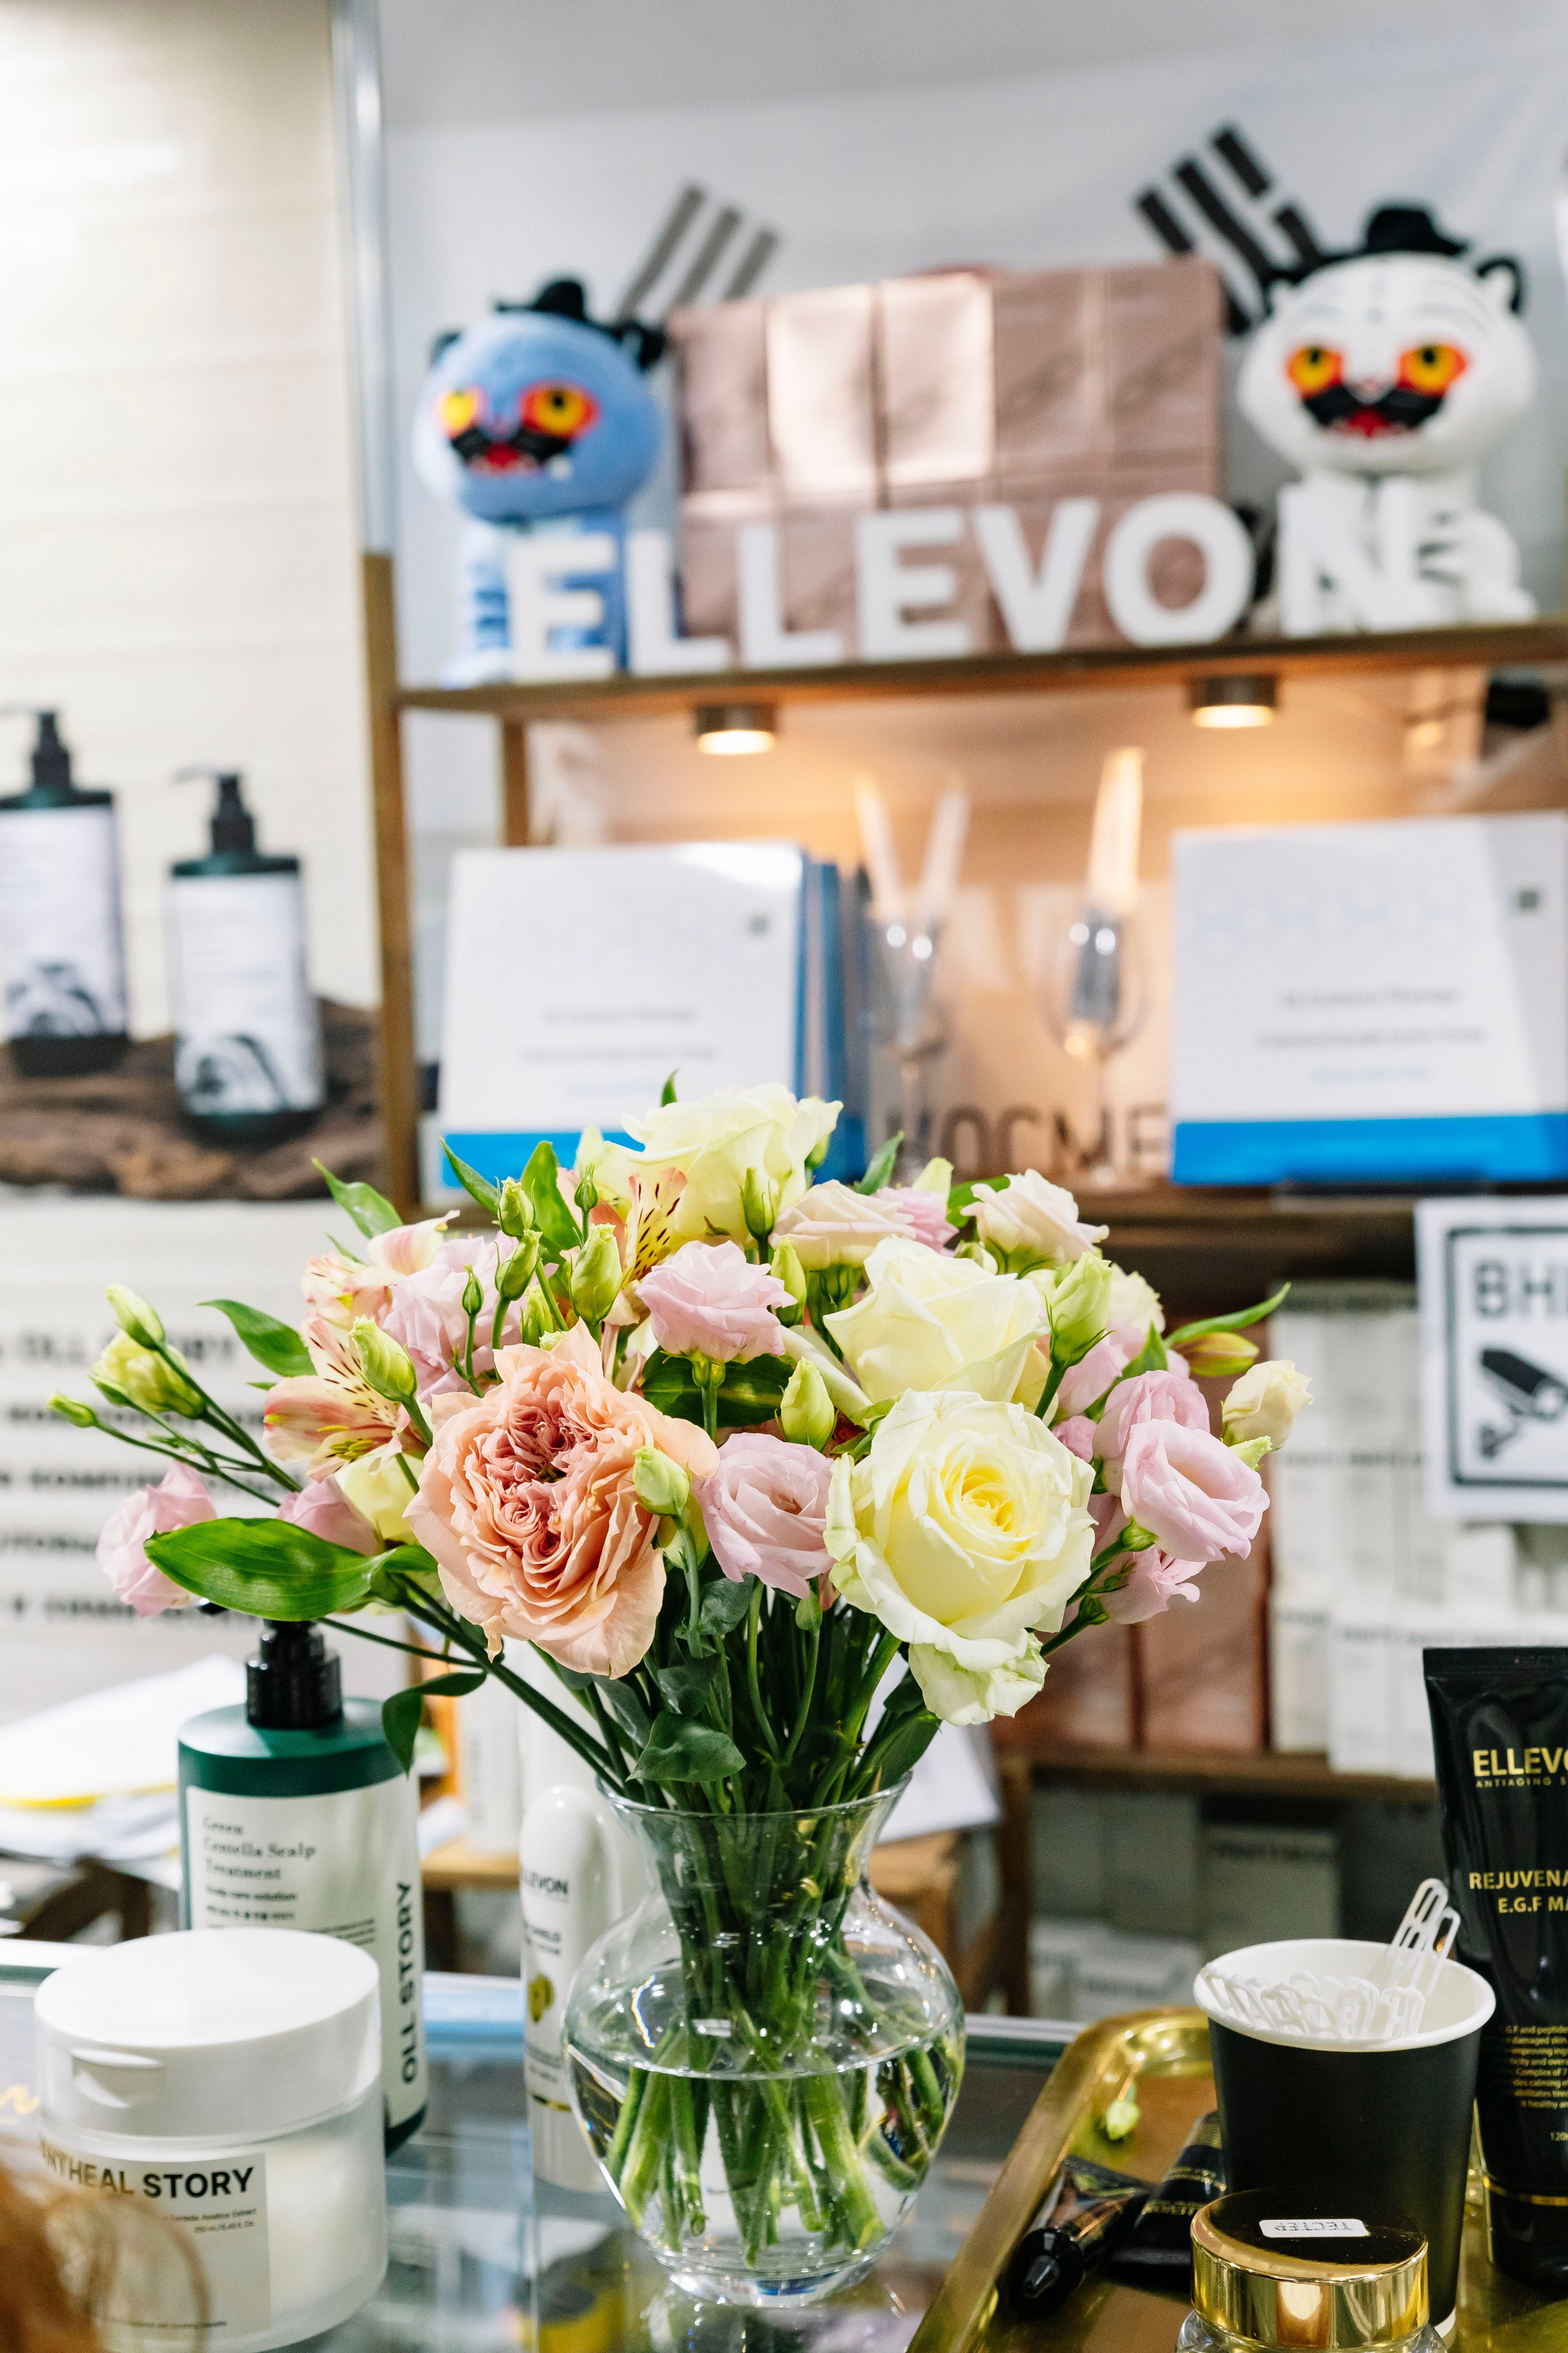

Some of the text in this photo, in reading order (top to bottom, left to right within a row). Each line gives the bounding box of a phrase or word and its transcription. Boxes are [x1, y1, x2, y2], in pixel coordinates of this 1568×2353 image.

[507, 481, 1421, 680] ELLEVON
[1473, 1256, 1568, 1320] ВН
[1473, 1747, 1568, 1777] ELLEV
[1476, 1776, 1552, 1789] ANTIAGING
[203, 1837, 317, 1861] Centella Scalp
[205, 1858, 281, 1879] Treatment
[1498, 1895, 1568, 1914] E.G.F M
[396, 1881, 418, 2085] OLL STORY
[1520, 2025, 1536, 2034] and
[1511, 2036, 1550, 2046] damaged
[1511, 2047, 1553, 2057] improving
[1531, 2057, 1547, 2066] and
[1515, 2068, 1551, 2077] Complex
[1550, 2131, 1568, 2142] 120
[143, 2166, 254, 2199] STORY
